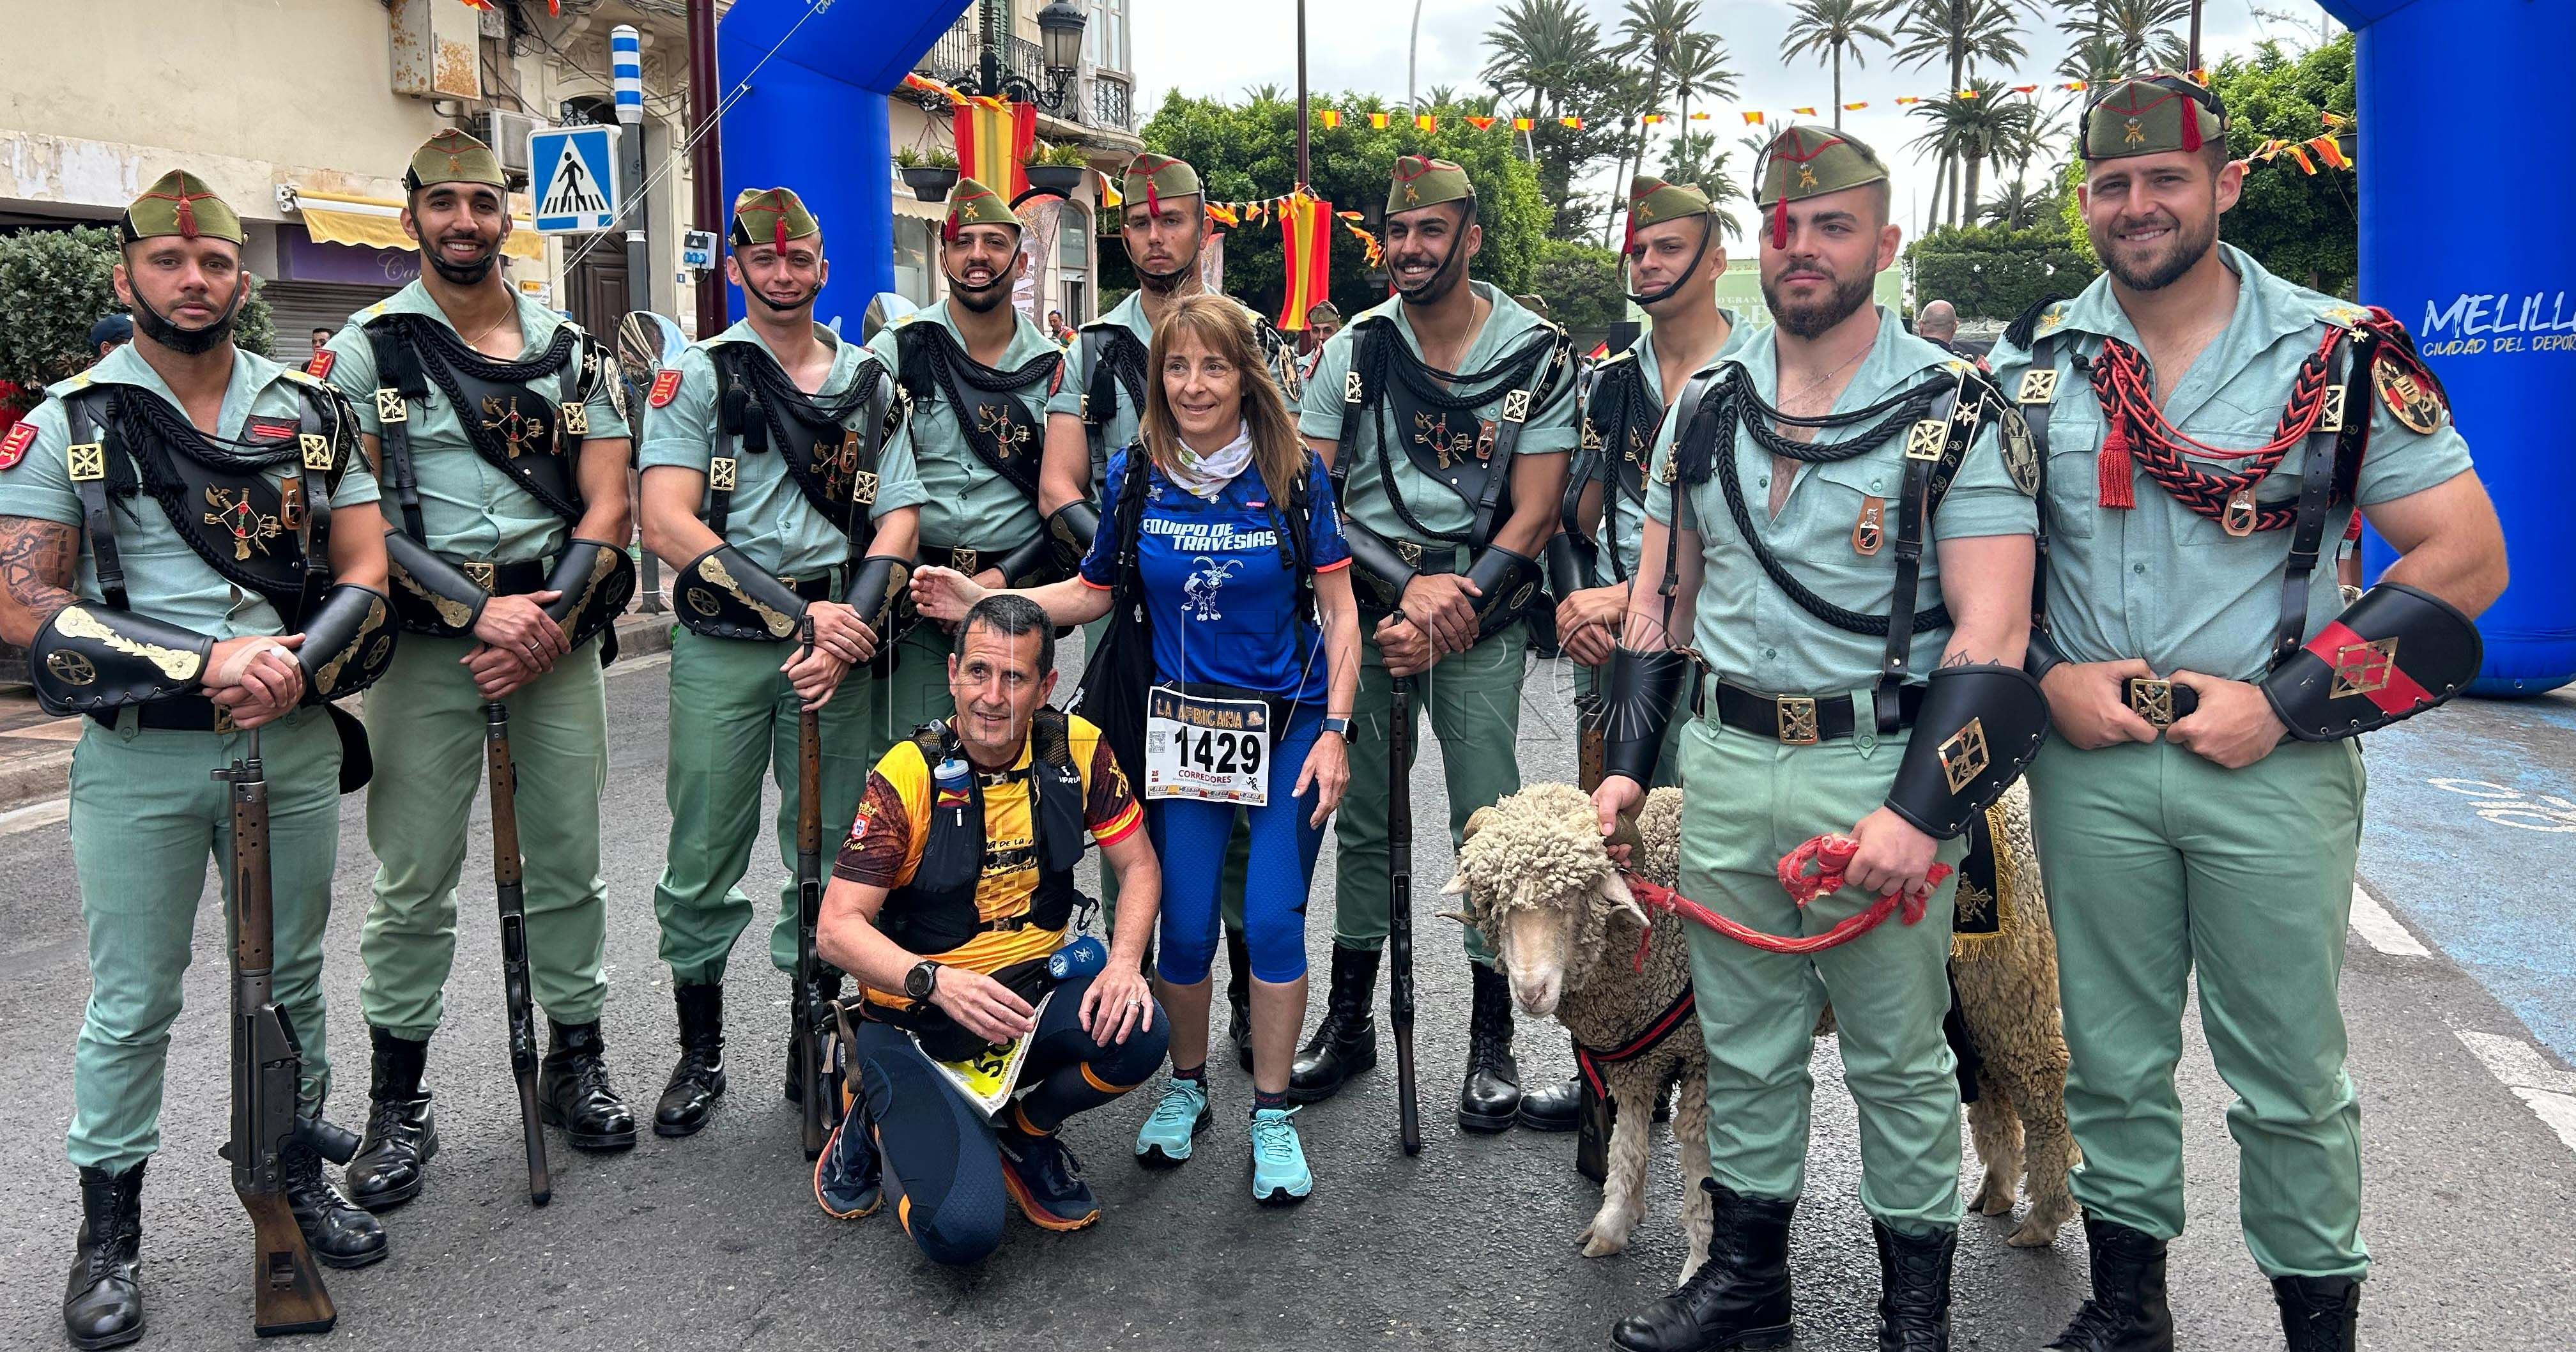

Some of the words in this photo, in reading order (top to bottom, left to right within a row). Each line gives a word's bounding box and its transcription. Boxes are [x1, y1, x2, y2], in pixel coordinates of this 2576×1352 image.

[2421, 291, 2576, 339] MELILL
[2422, 338, 2487, 357] CIUDAD
[2493, 337, 2525, 352] DEL
[1143, 518, 1209, 537] EQUIPO
[1209, 523, 1236, 538] DE
[1156, 698, 1172, 718] LA
[1177, 704, 1243, 729] AFRICANA
[1174, 725, 1261, 775] 1429
[1178, 769, 1232, 783] CORREDORES
